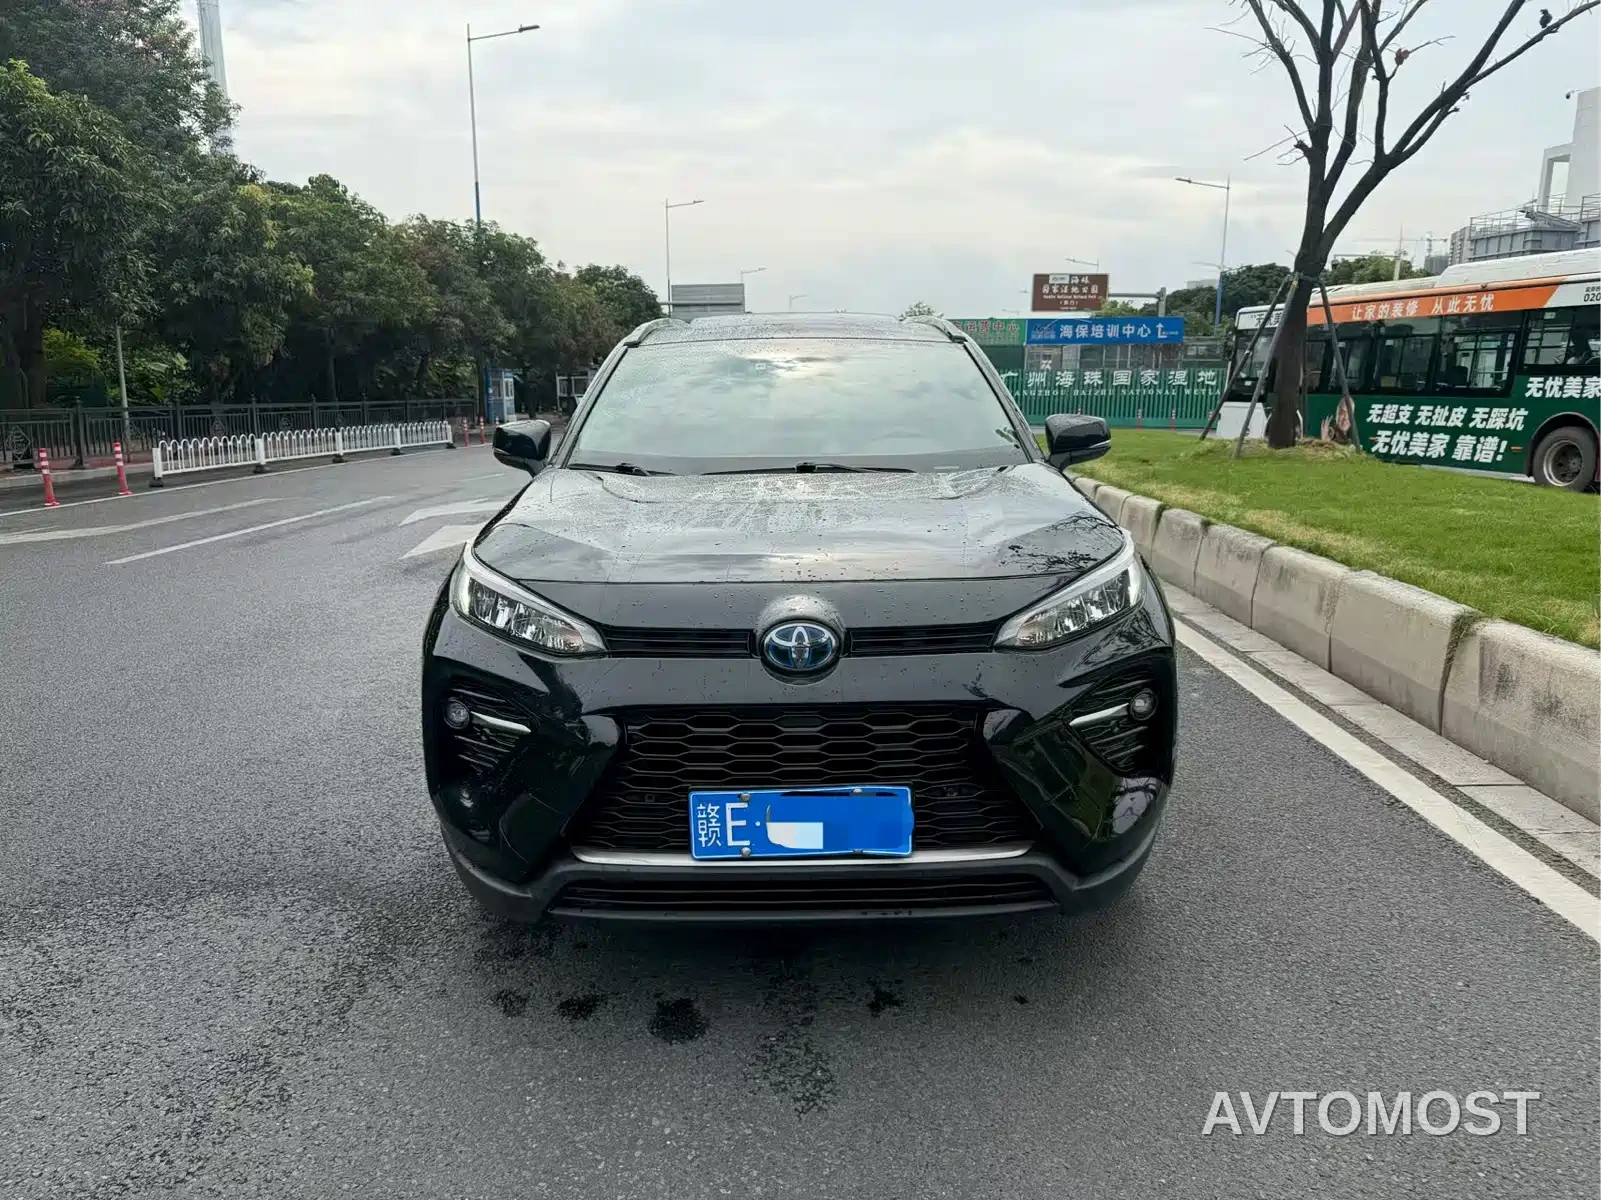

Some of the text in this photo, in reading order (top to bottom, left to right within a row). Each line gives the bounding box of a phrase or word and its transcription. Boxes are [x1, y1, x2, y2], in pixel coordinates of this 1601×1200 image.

[1352, 293, 1495, 321] 让家的装修 从此无忧
[1060, 323, 1151, 339] 海保培训中心
[1525, 376, 1601, 399] 无忧美家
[1366, 403, 1528, 431] 无超支 无扯皮 无踩坑
[1371, 430, 1449, 459] 无忧美家
